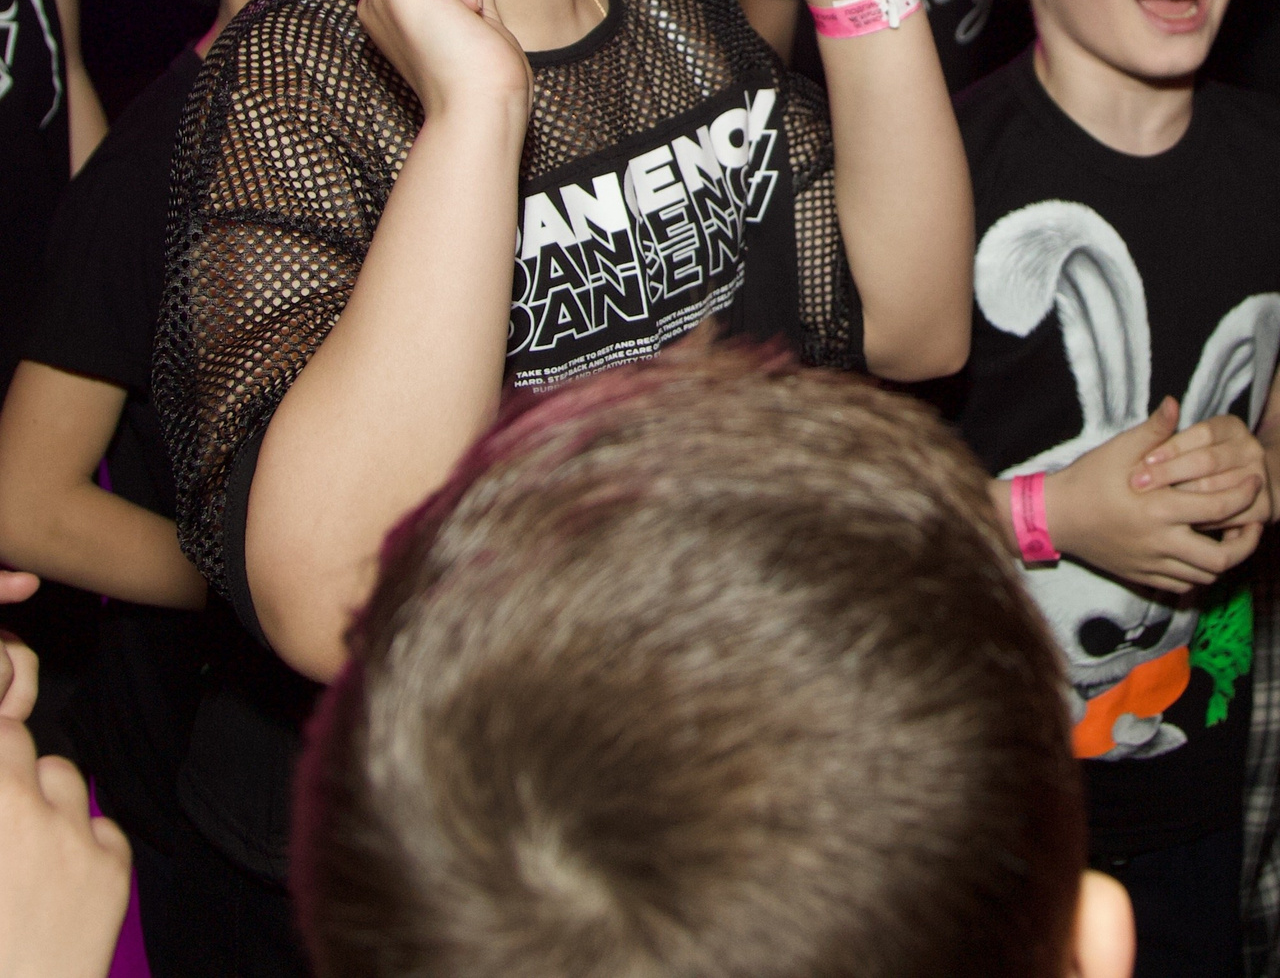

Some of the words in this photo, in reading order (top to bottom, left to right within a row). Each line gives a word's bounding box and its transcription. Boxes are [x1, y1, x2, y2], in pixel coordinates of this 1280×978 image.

[514, 377, 545, 388] HARD.
[568, 363, 587, 376] BACK
[588, 358, 604, 369] AND
[605, 350, 625, 362] TAKE
[626, 345, 652, 357] CARE
[516, 369, 542, 379] TAKE
[544, 363, 568, 375] SOME
[568, 355, 585, 367] TIME
[586, 352, 596, 361] TO
[597, 344, 614, 357] REST
[614, 340, 635, 350] AND
